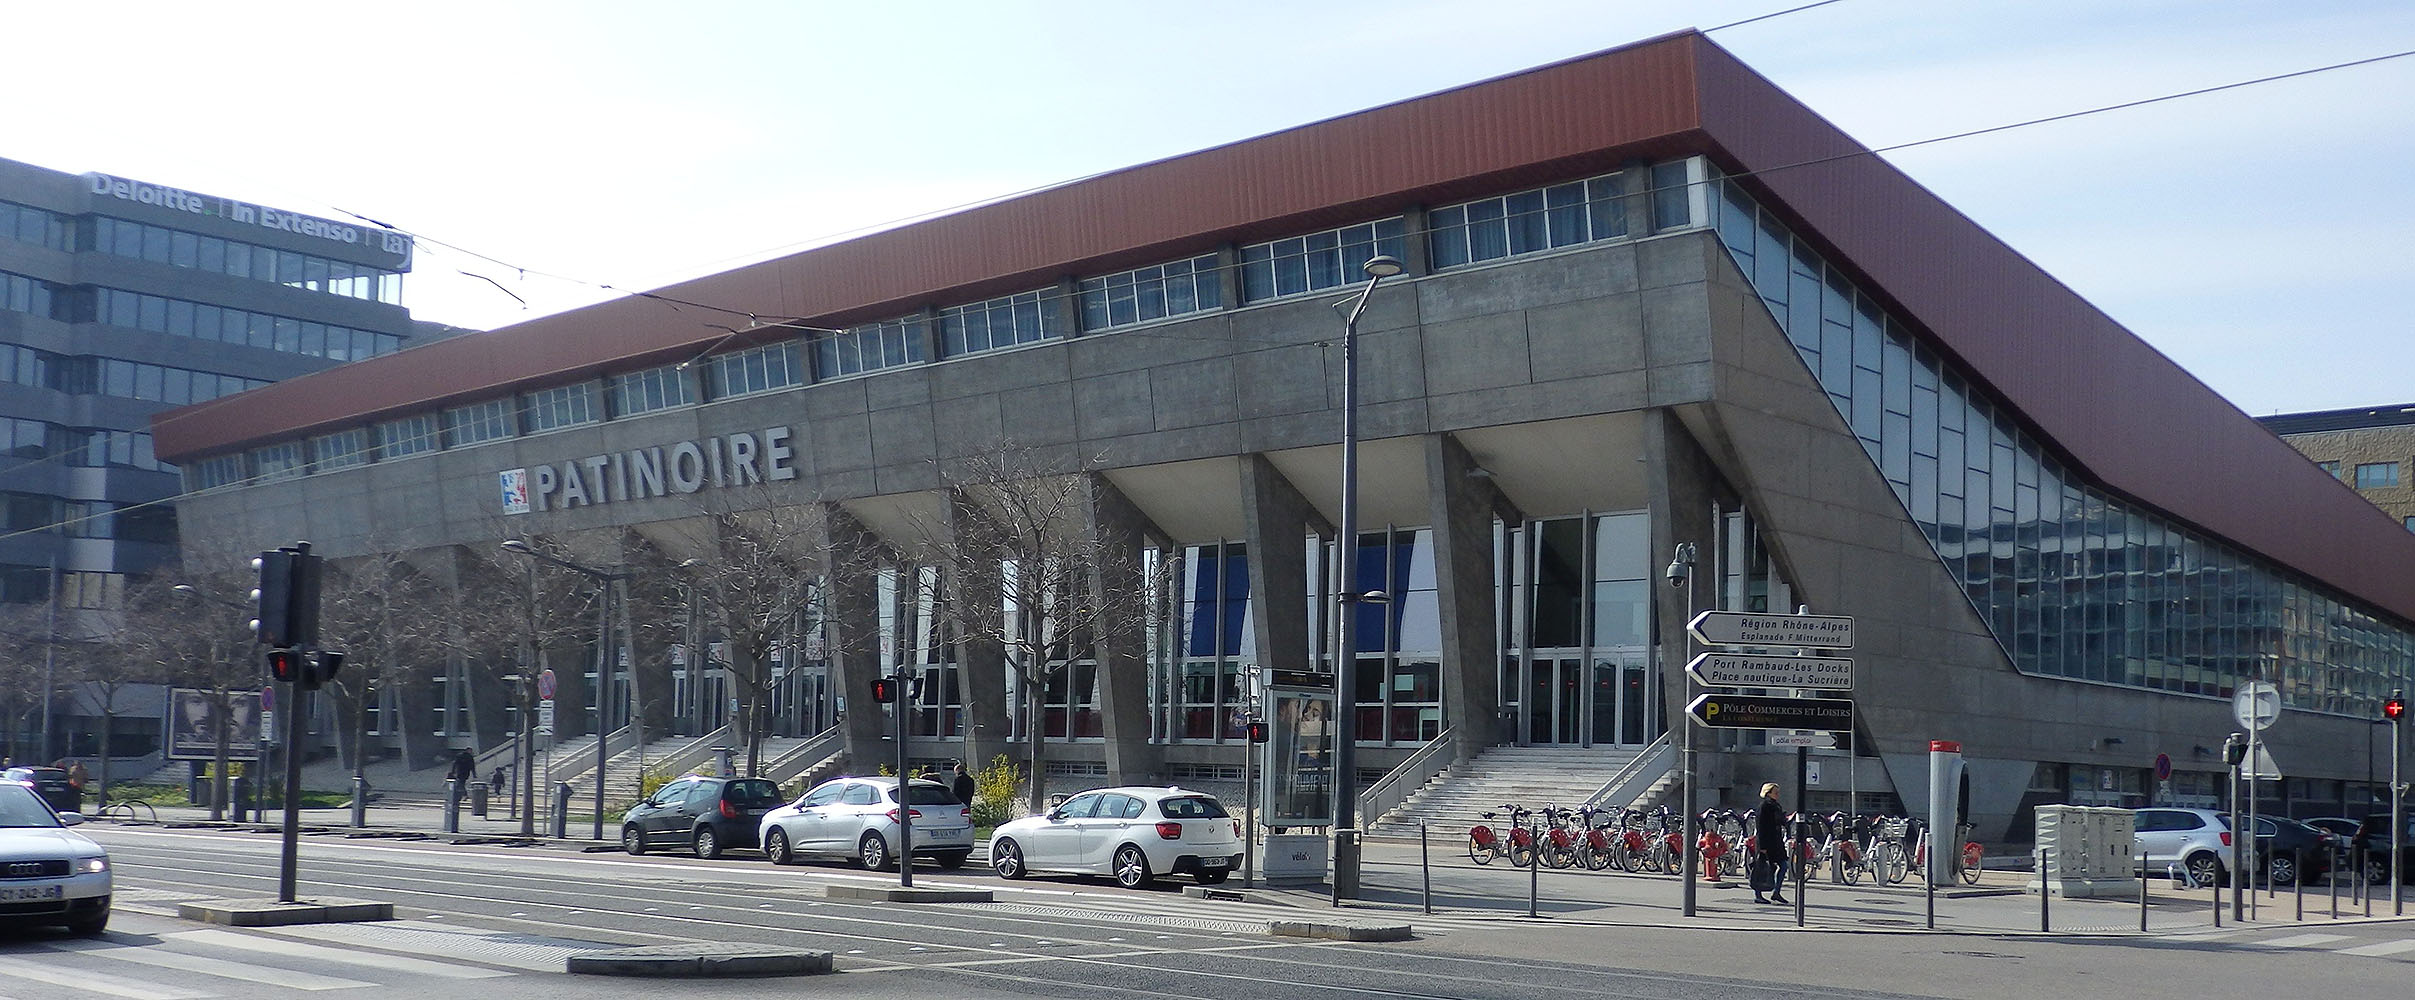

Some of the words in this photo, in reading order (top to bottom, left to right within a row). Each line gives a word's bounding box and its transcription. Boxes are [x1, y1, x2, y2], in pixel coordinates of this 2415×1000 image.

[231, 199, 255, 225] In
[260, 206, 357, 244] Extenso
[379, 230, 413, 269] Taj
[534, 425, 796, 512] PATINOIRE
[1741, 618, 1777, 630] Région
[1783, 619, 1849, 633] Rhône-Alpes
[1741, 632, 1784, 642] Esplanade
[1796, 633, 1841, 643] Mitterrand
[1713, 659, 1736, 669] Port
[1741, 660, 1812, 672] Rambaud-Les
[1817, 663, 1849, 673] Docks
[1711, 671, 1739, 681] Place
[1743, 673, 1803, 684] nautique-La
[1807, 674, 1849, 685] Sucrière
[1706, 702, 1720, 720] P
[1723, 703, 1746, 713] PÔLE
[1747, 704, 1803, 715] COMMERCES
[1804, 707, 1815, 715] ET
[1816, 706, 1851, 717] LOISIRS
